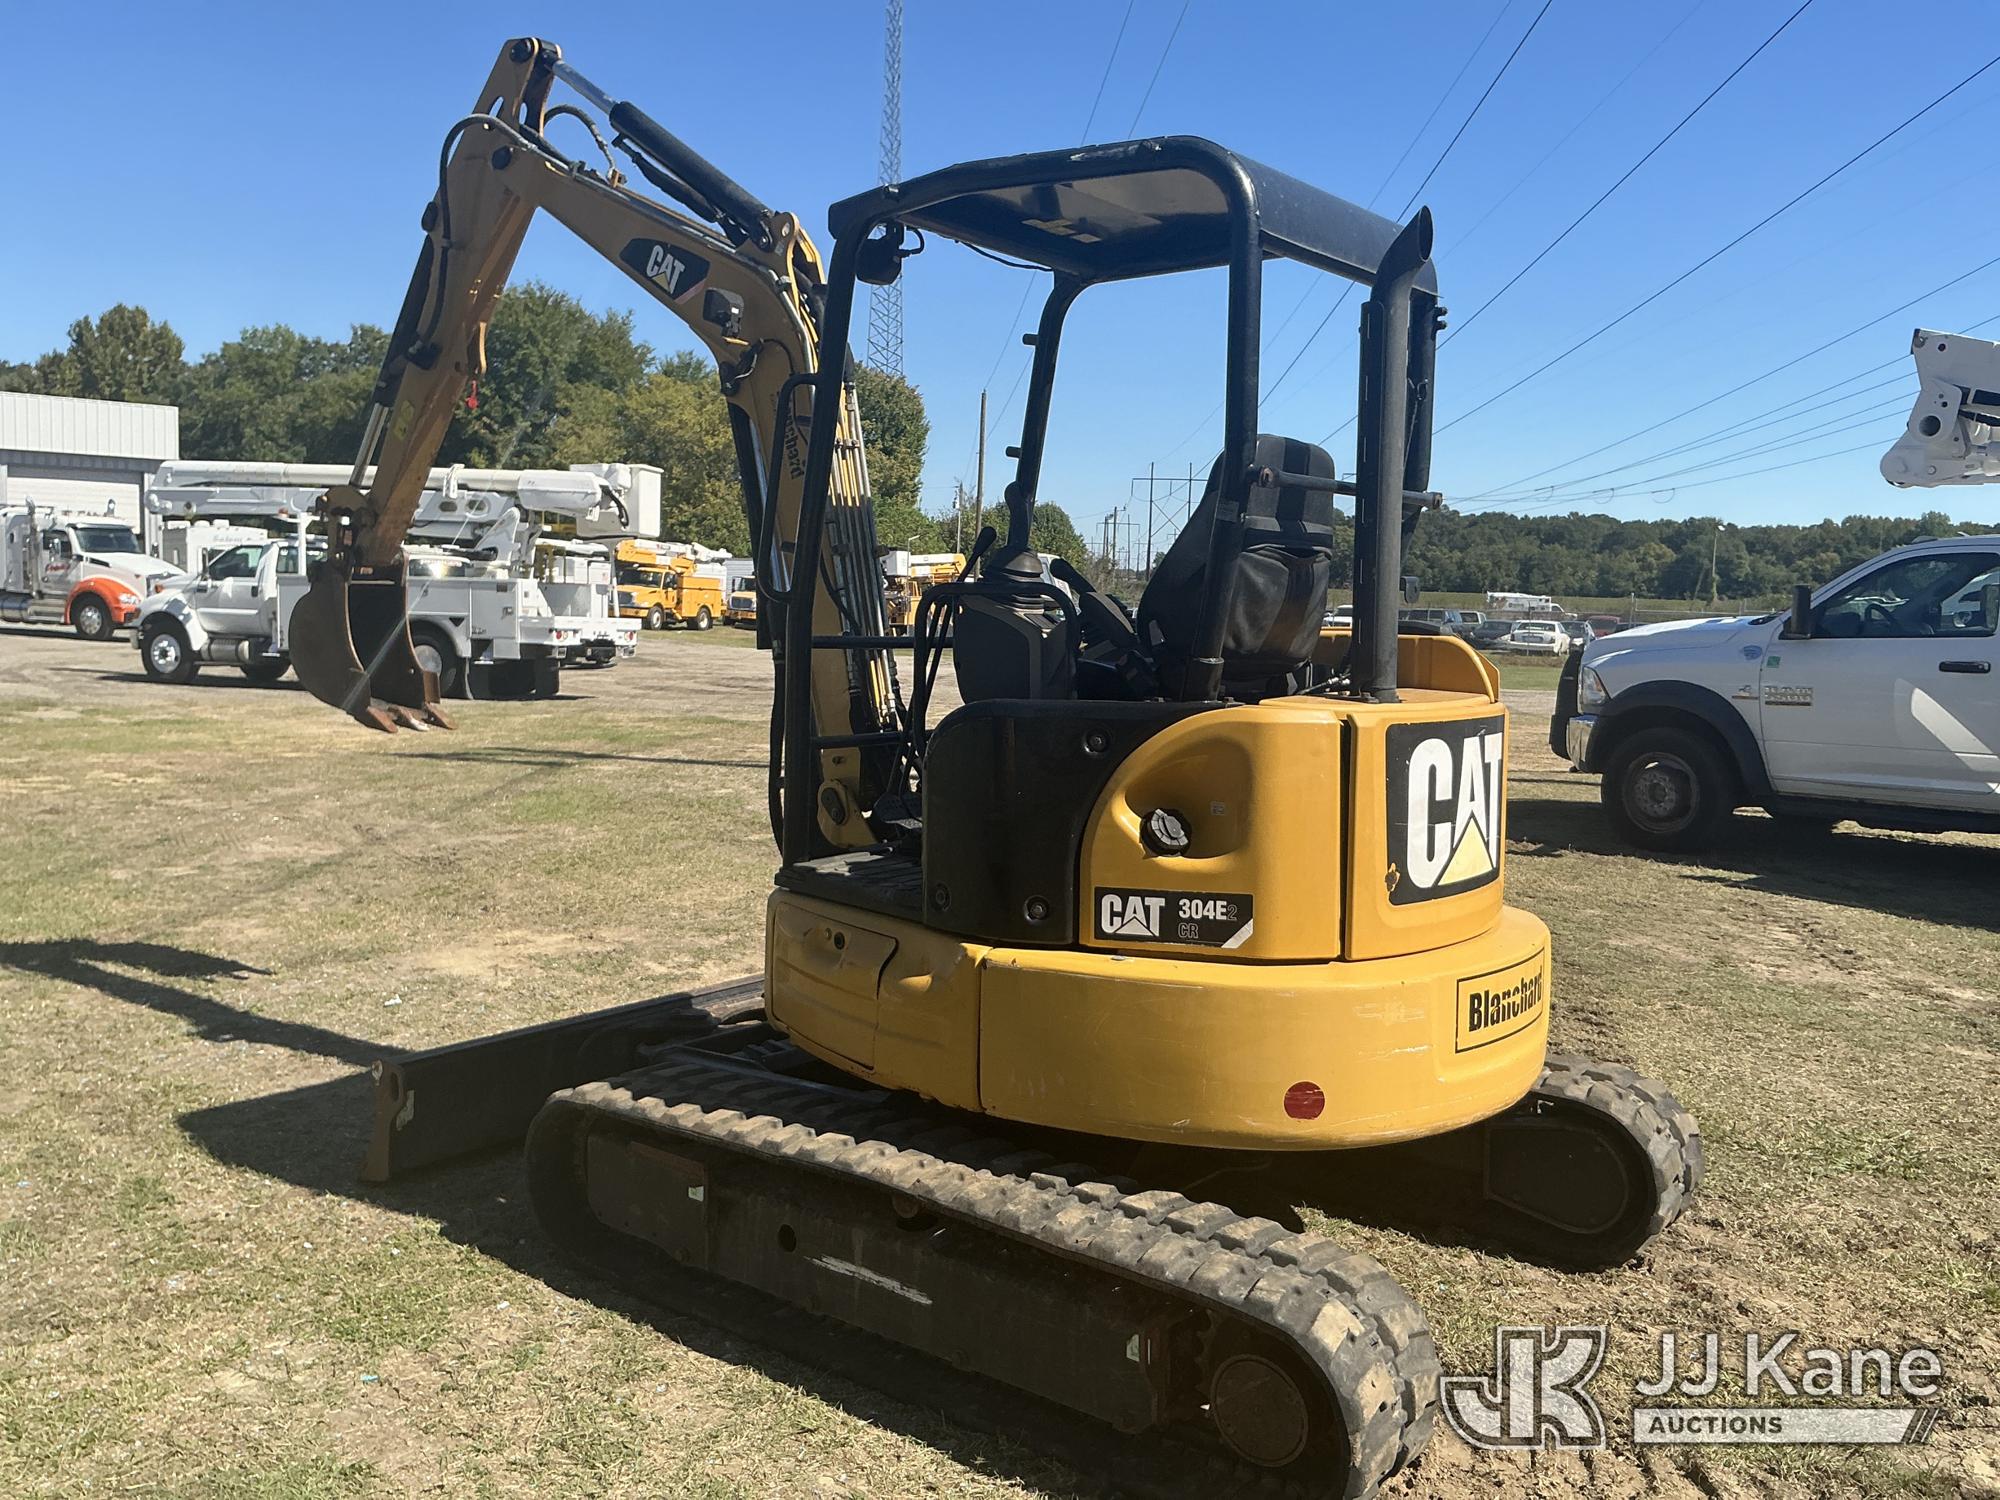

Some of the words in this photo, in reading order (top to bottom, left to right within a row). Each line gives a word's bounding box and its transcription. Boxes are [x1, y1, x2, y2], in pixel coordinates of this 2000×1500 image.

[646, 245, 686, 295] CAT
[1407, 732, 1502, 888] CAT
[1101, 894, 1165, 937] CAT
[1178, 923, 1199, 938] CR
[1469, 966, 1542, 1032] Blanchard
